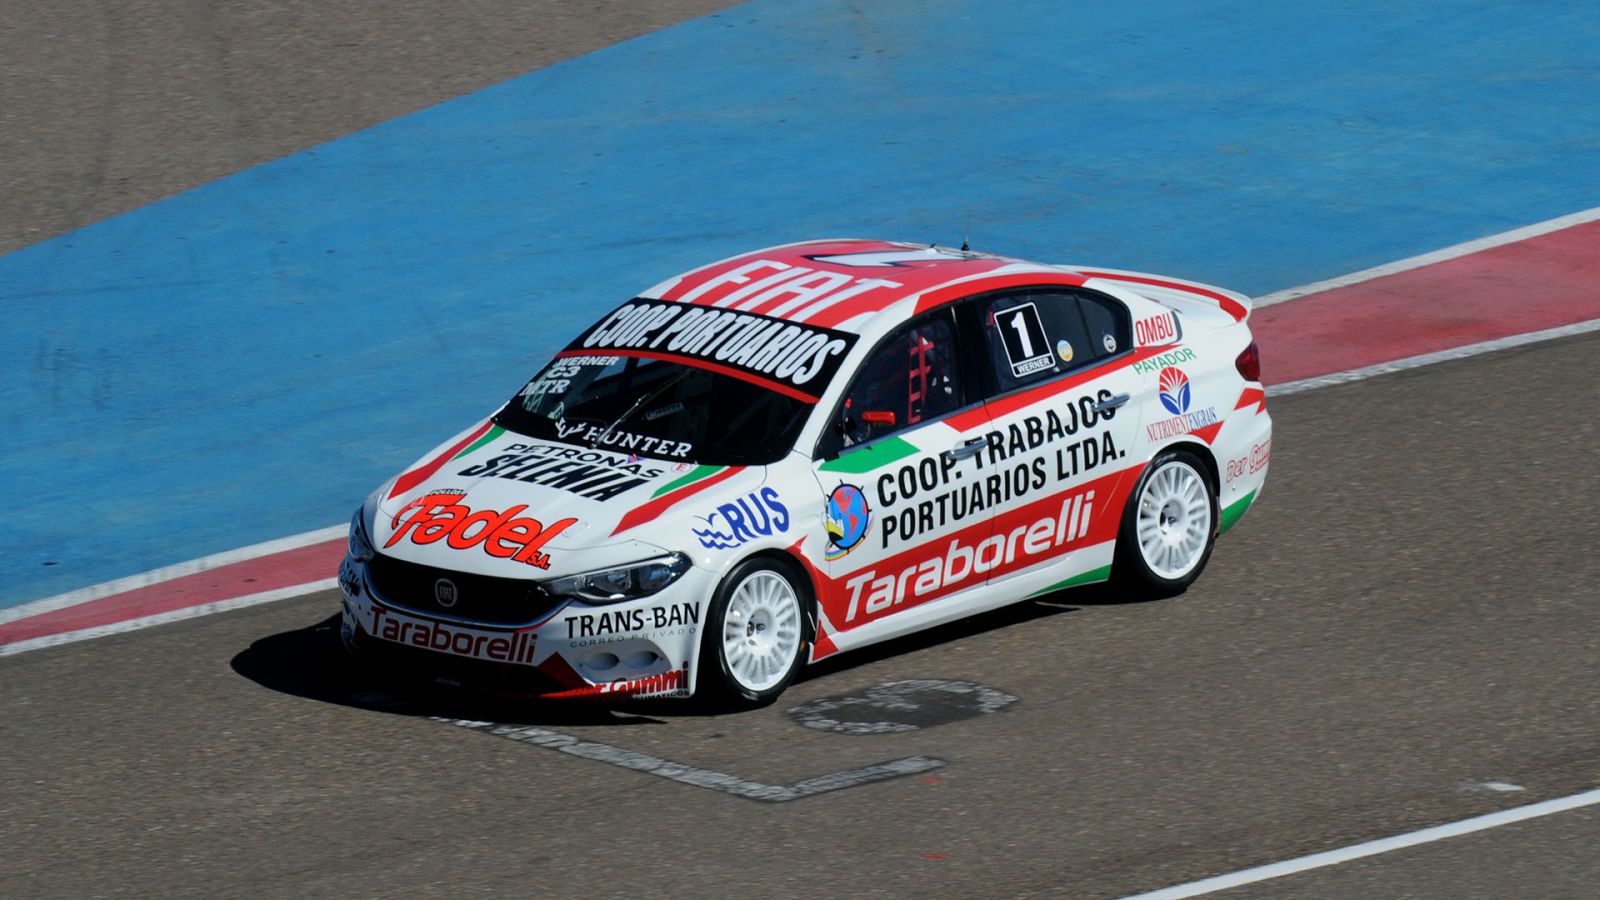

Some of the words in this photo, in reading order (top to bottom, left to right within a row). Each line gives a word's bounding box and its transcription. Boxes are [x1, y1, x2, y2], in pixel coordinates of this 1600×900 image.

[676, 259, 904, 322] FIAT
[649, 307, 847, 385] PORTUARIOS
[1011, 311, 1034, 358] 1
[1135, 312, 1174, 347] OMBU
[556, 356, 619, 366] WERNER
[1016, 357, 1050, 373] WERNER
[1132, 347, 1197, 375] PAYADOR
[502, 443, 665, 479] PETRONAS
[583, 426, 692, 458] HUNTER
[877, 451, 961, 508] COOP.
[964, 389, 1117, 470] TRABAJOS
[457, 454, 650, 502] SELENIA
[882, 455, 1046, 549] PORTUARIOS
[1057, 430, 1126, 480] LTDA.
[383, 494, 579, 563] Fadel
[716, 487, 789, 543] RUS
[845, 489, 1095, 622] Taraborelli
[370, 605, 538, 664] Taraborelli
[565, 601, 699, 639] TRANS-BAN
[570, 635, 625, 648] CORREO
[631, 627, 697, 640] PRIVADO
